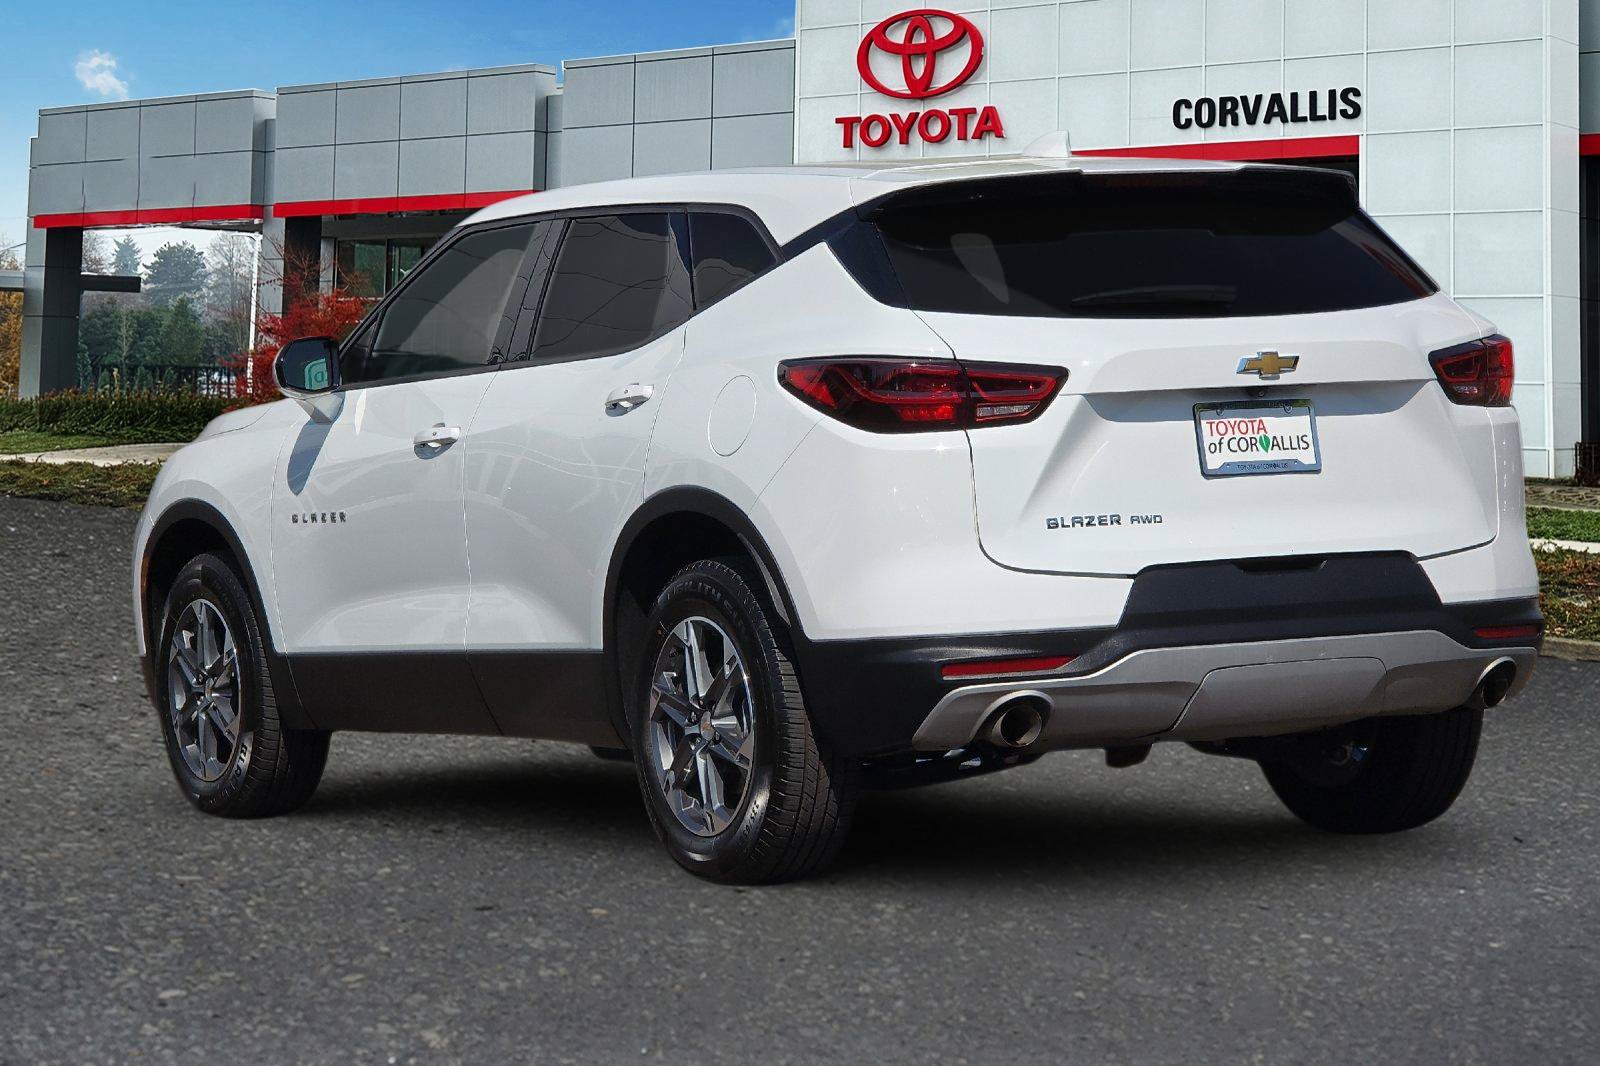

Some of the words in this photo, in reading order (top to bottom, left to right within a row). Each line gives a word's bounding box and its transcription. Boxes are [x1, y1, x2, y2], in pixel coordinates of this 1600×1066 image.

[1172, 87, 1362, 130] CORVALLIS
[835, 105, 1005, 148] TOYOTA
[1206, 418, 1268, 437] TOYOTA
[1208, 436, 1224, 454] of
[291, 511, 347, 524] BLAZER
[1046, 513, 1122, 530] BLAZER
[1130, 514, 1163, 525] AWD
